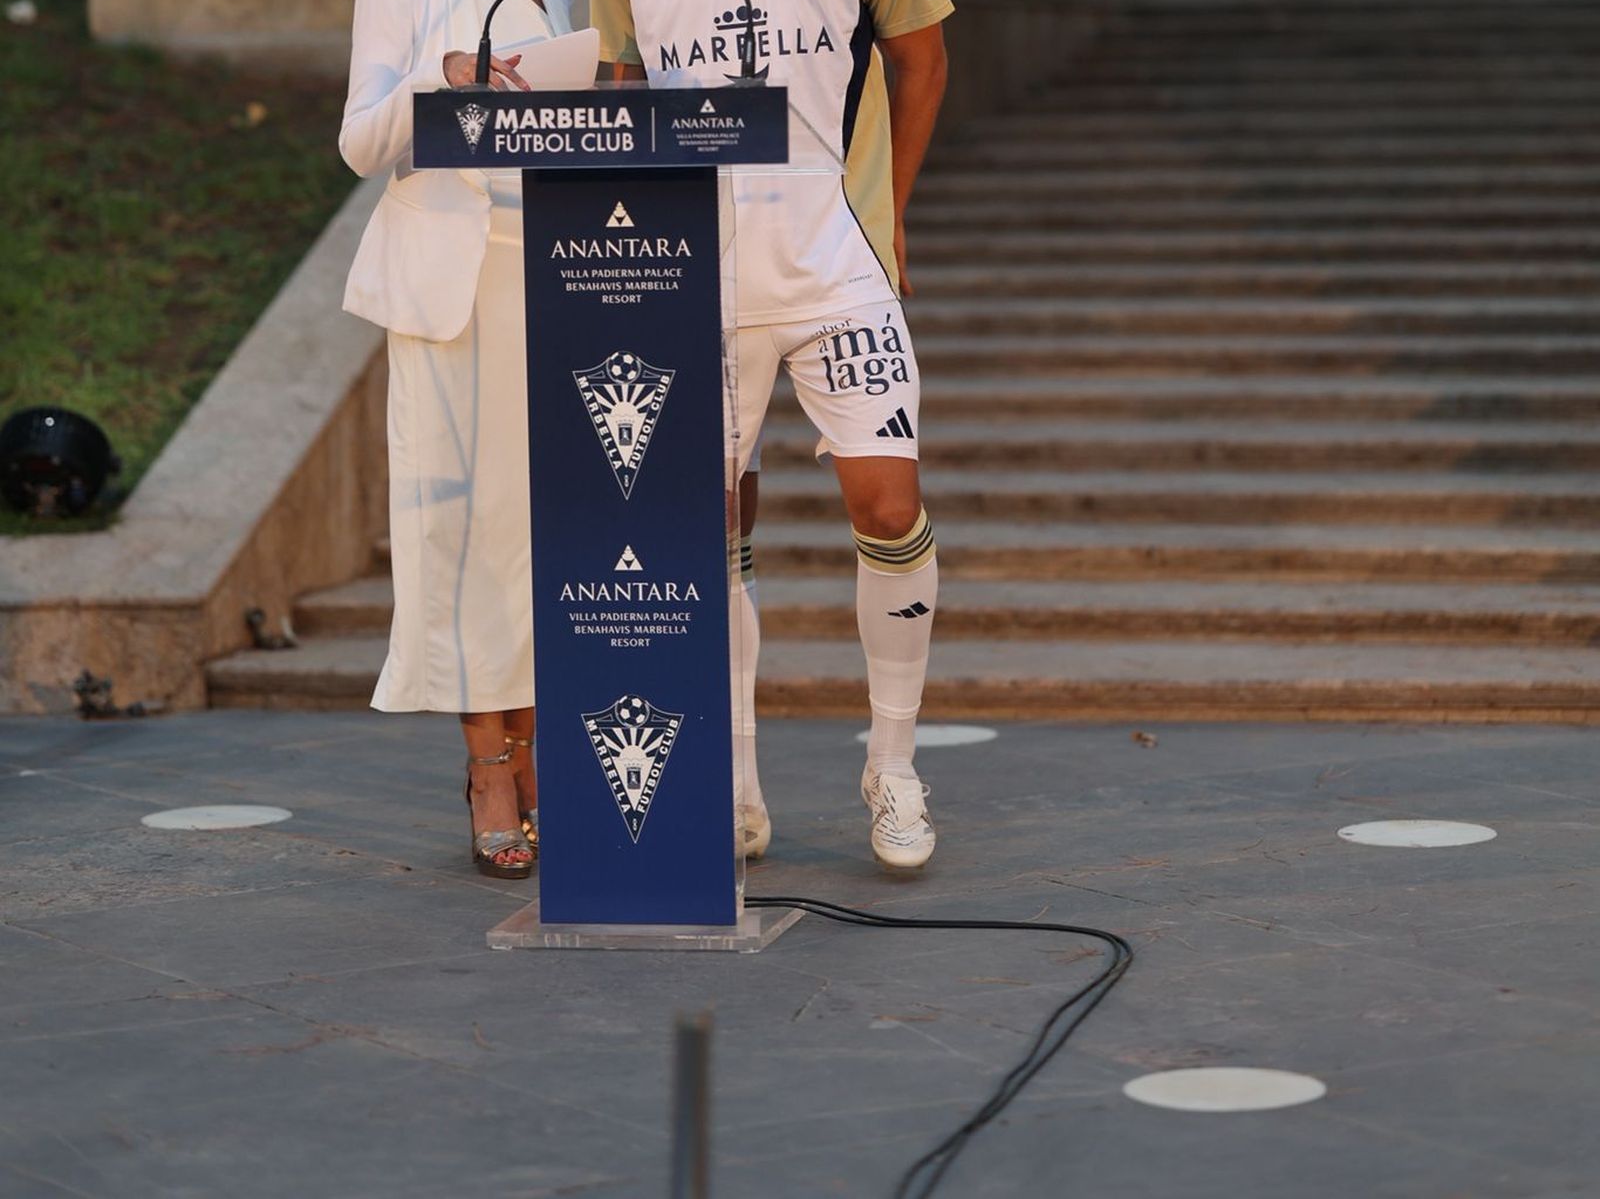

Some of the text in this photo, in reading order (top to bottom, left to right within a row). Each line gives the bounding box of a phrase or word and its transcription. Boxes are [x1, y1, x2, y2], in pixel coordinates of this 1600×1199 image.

[494, 107, 634, 130] MARBELLA
[671, 117, 745, 129] ANANTARA
[494, 126, 575, 153] FÚTBOL
[580, 132, 634, 152] CLUB
[550, 238, 693, 259] ANANTARA
[560, 267, 683, 278] VILLA PADIERNA PALACE
[566, 281, 679, 291] BENAHAVIS MARBELLA
[602, 294, 642, 304] RESORT
[821, 355, 910, 395] laga
[578, 375, 623, 470] MARBELLA
[628, 374, 671, 470] FUTBOL CLUB
[559, 582, 701, 601] ANANTARA
[569, 612, 691, 621] VILLA PADIERNA PALACE
[574, 625, 688, 634] BENAHAVIS MARBELLA
[610, 638, 651, 647] RESORT
[586, 718, 631, 813] MARBELLA
[637, 719, 679, 813] FUTBOL CLUB
